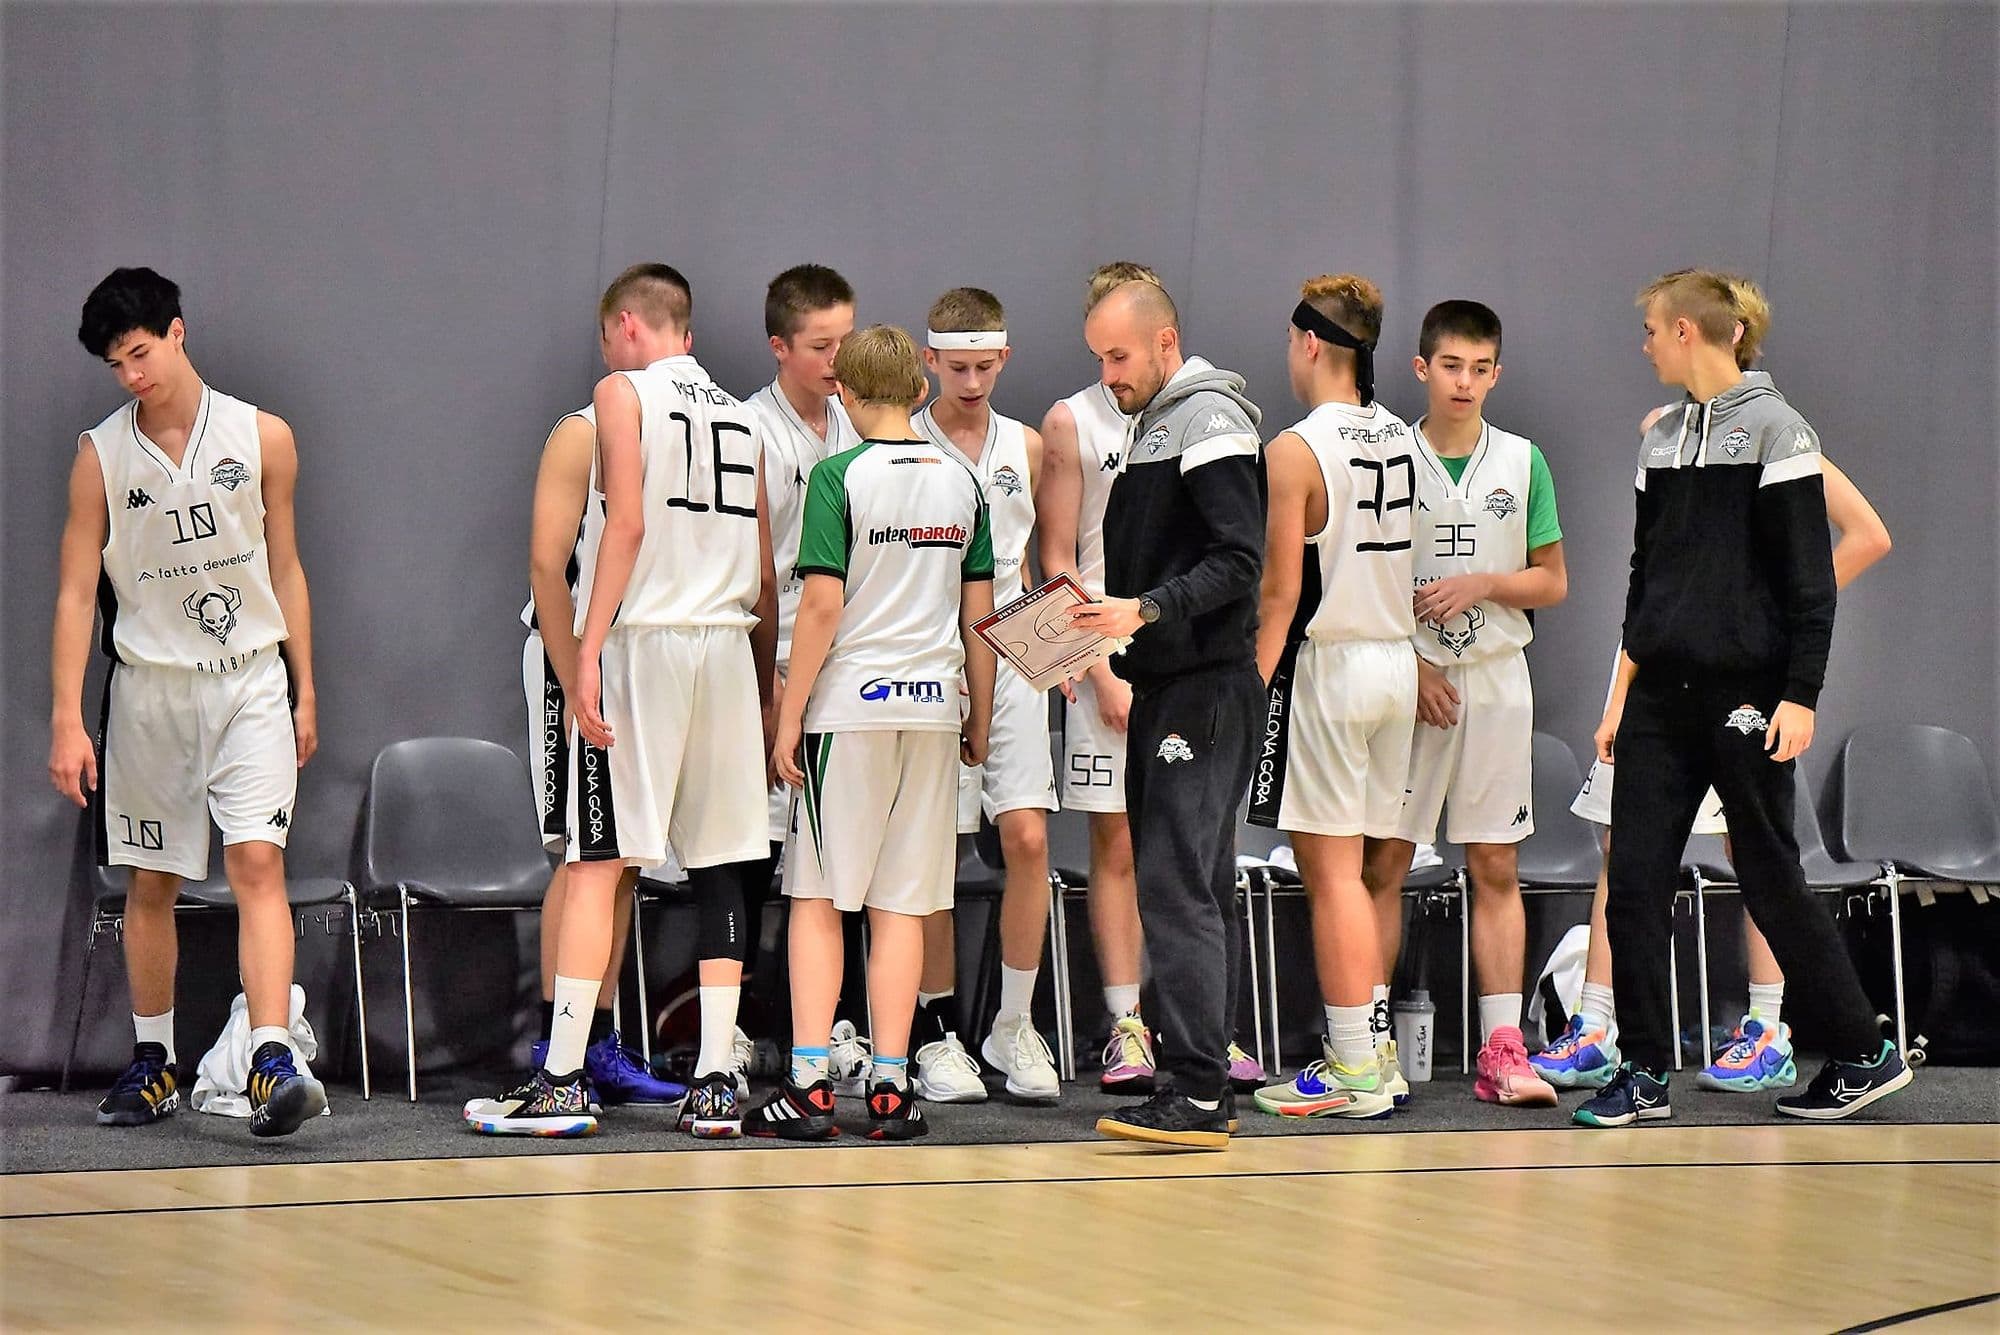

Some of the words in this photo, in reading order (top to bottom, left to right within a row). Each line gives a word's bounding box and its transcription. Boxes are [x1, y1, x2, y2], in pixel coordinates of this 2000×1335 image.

[165, 502, 217, 545] 10
[1435, 524, 1476, 557] 35
[158, 565, 198, 580] fatto
[544, 698, 560, 767] ZIELONA
[1261, 687, 1284, 757] ZIELONA
[1071, 754, 1112, 787] 55
[1254, 759, 1275, 806] GÓRA
[118, 813, 164, 851] 10
[588, 794, 605, 845] GÓRA
